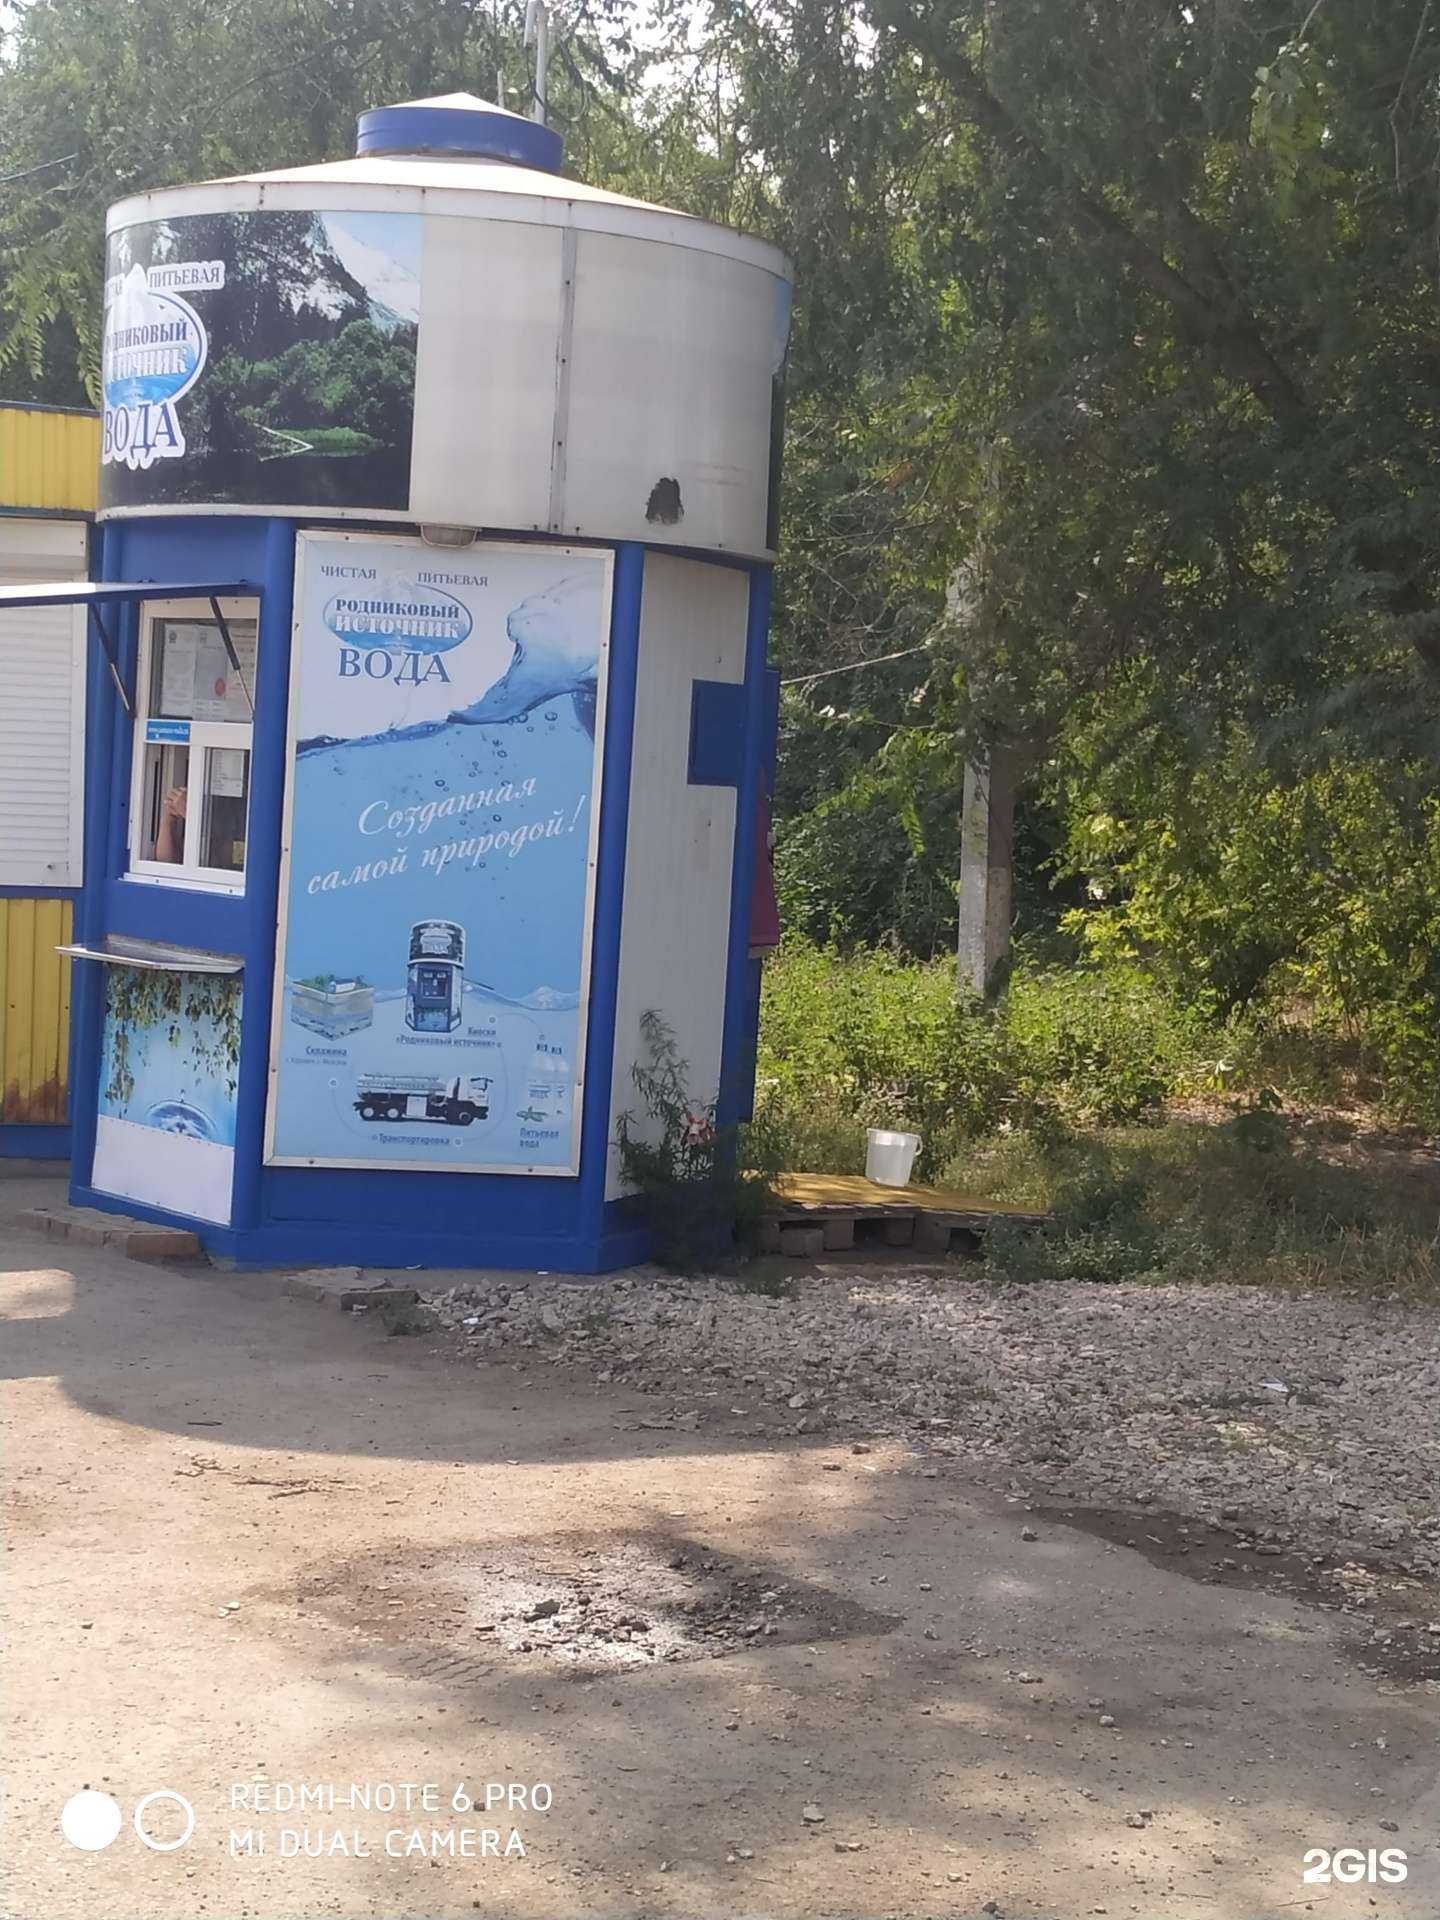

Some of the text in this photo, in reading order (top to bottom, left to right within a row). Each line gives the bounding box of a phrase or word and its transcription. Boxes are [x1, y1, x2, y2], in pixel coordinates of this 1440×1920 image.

[149, 267, 220, 288] ПИТЬЕВАЯ
[105, 403, 178, 458] ВОДА
[321, 565, 488, 587] ЧИСТАЯ ПИТЬЕВАЯ
[335, 598, 460, 619] РОДНИКОВЫЙ
[335, 615, 460, 639] ИСТОЧНИК
[338, 648, 450, 686] ВОДА
[358, 776, 537, 838] Созданная
[308, 794, 587, 895] самой природой!
